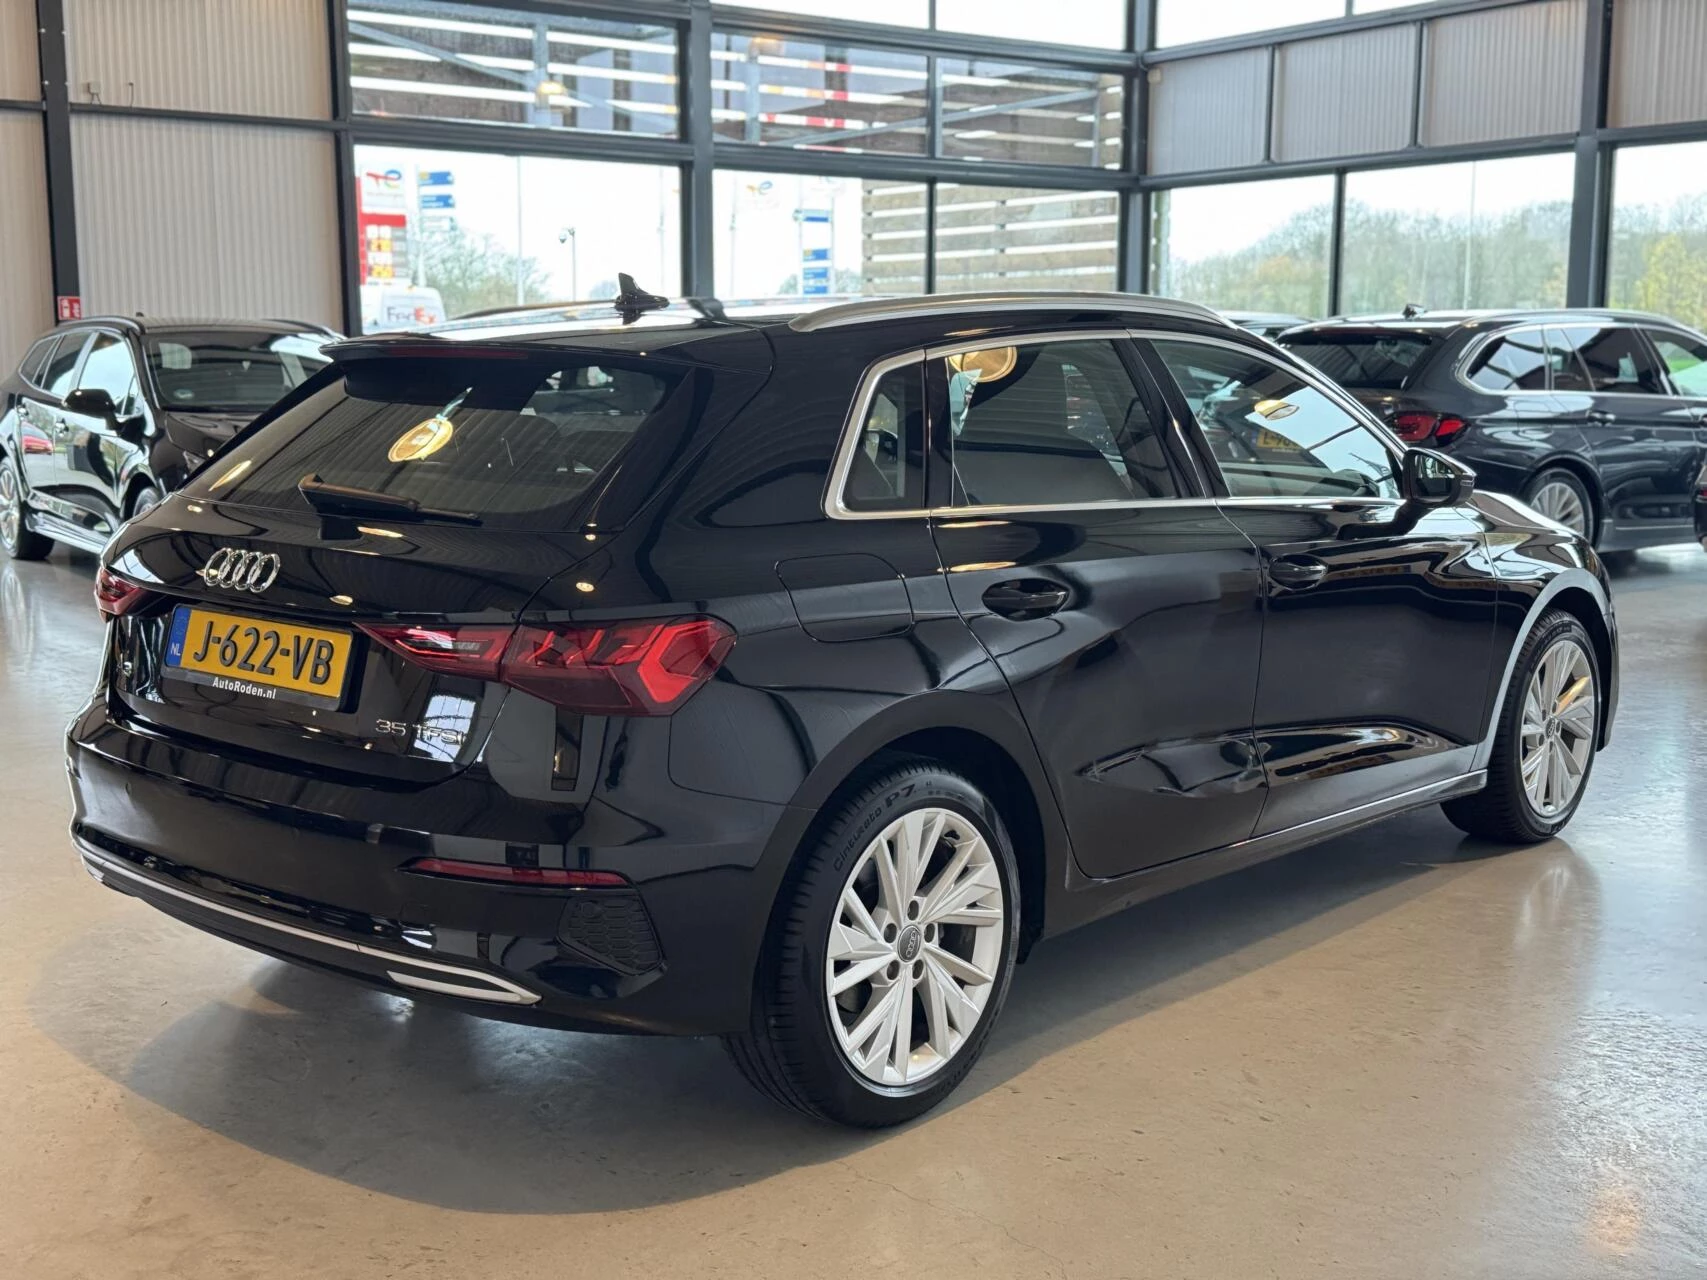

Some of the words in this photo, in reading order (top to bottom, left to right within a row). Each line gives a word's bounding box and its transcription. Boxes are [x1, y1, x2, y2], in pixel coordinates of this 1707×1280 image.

[170, 642, 181, 657] NL
[193, 620, 335, 685] J-622-VB
[212, 676, 277, 700] AutoRoden.nl
[375, 718, 407, 737] 35
[412, 724, 467, 746] TFSI
[885, 783, 916, 808] P7
